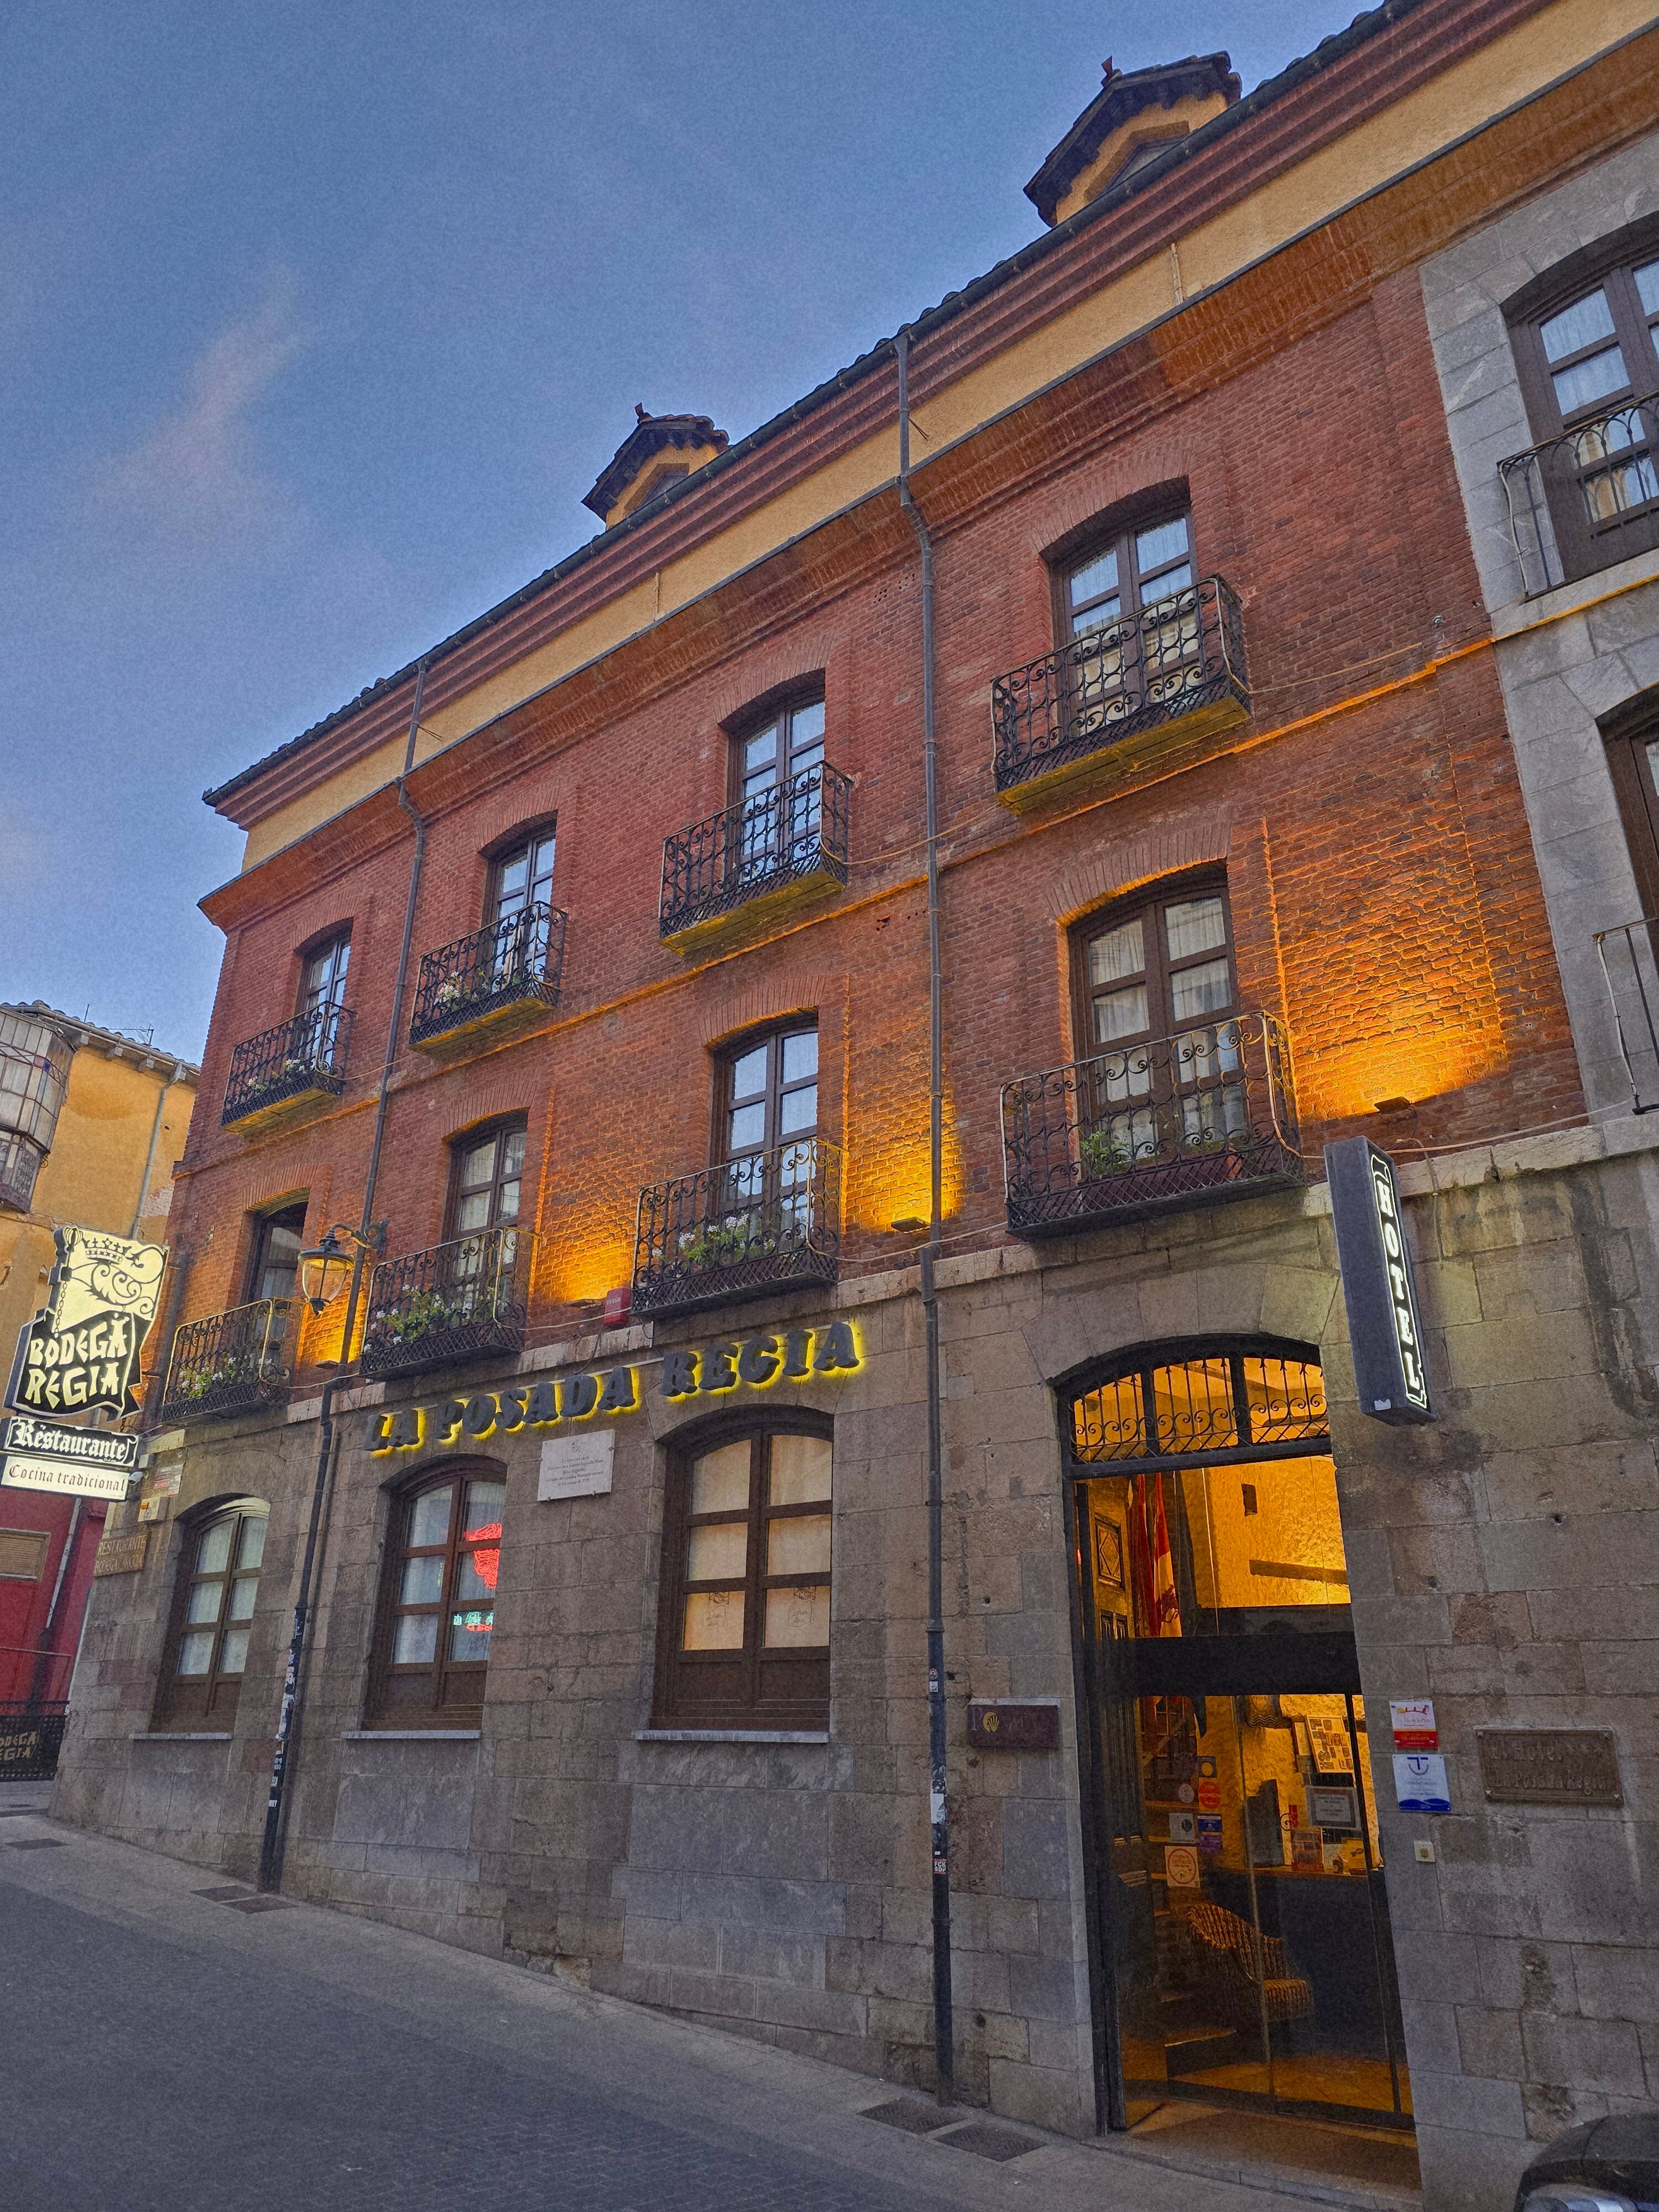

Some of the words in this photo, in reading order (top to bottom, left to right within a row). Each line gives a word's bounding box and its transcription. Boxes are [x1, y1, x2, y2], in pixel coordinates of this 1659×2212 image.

[1376, 1179, 1421, 1391] HOTEL
[28, 1316, 130, 1371] BODEGA
[25, 1361, 119, 1410] REGIA
[362, 1409, 420, 1452] LA
[433, 1365, 637, 1440] POSADA
[658, 1322, 860, 1397] REGIA
[9, 1464, 53, 1483] Cocina
[58, 1471, 126, 1492] tradicional
[97, 1535, 147, 1556] RESTAURANTE
[94, 1558, 118, 1573] BODEGA
[0, 1731, 37, 1747] ODEGA
[0, 1746, 31, 1761] EGIA
